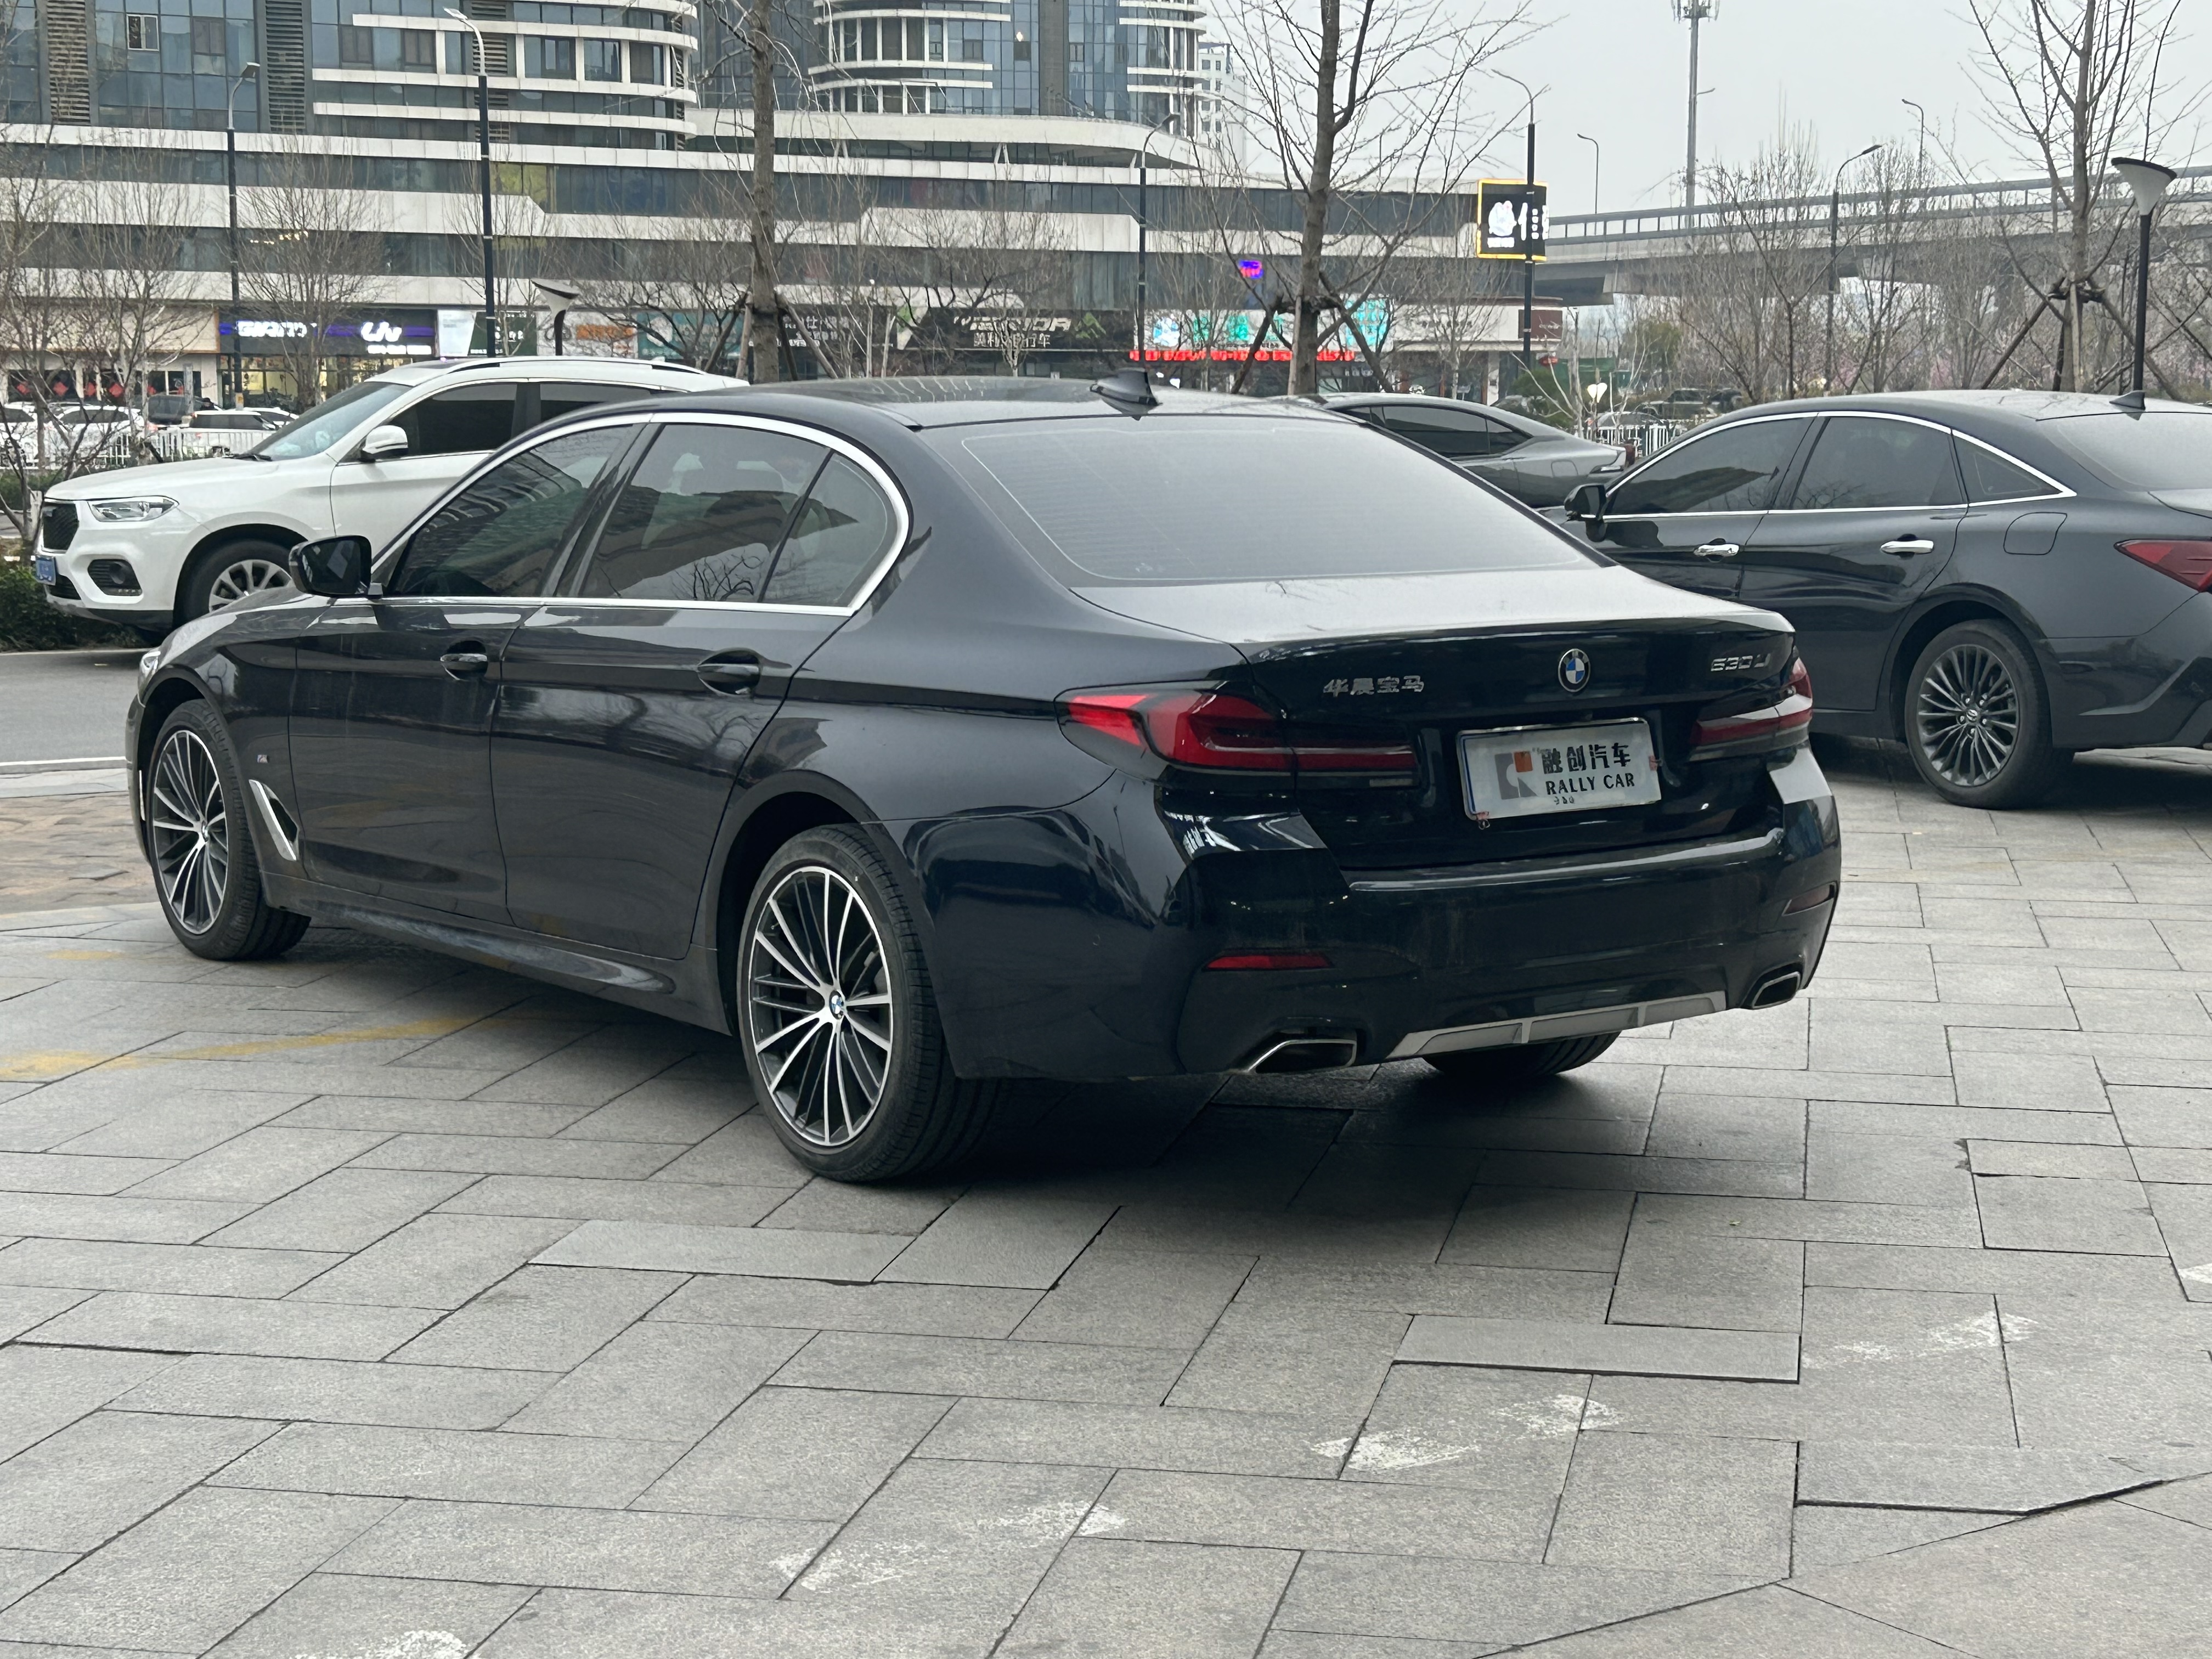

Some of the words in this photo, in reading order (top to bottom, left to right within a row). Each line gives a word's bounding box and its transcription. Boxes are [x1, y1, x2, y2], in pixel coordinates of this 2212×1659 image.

[1323, 675, 1425, 697] 华晨宝马
[1541, 742, 1631, 775] 融创汽车
[1545, 776, 1596, 795] RALLY
[1603, 772, 1635, 789] CAR
